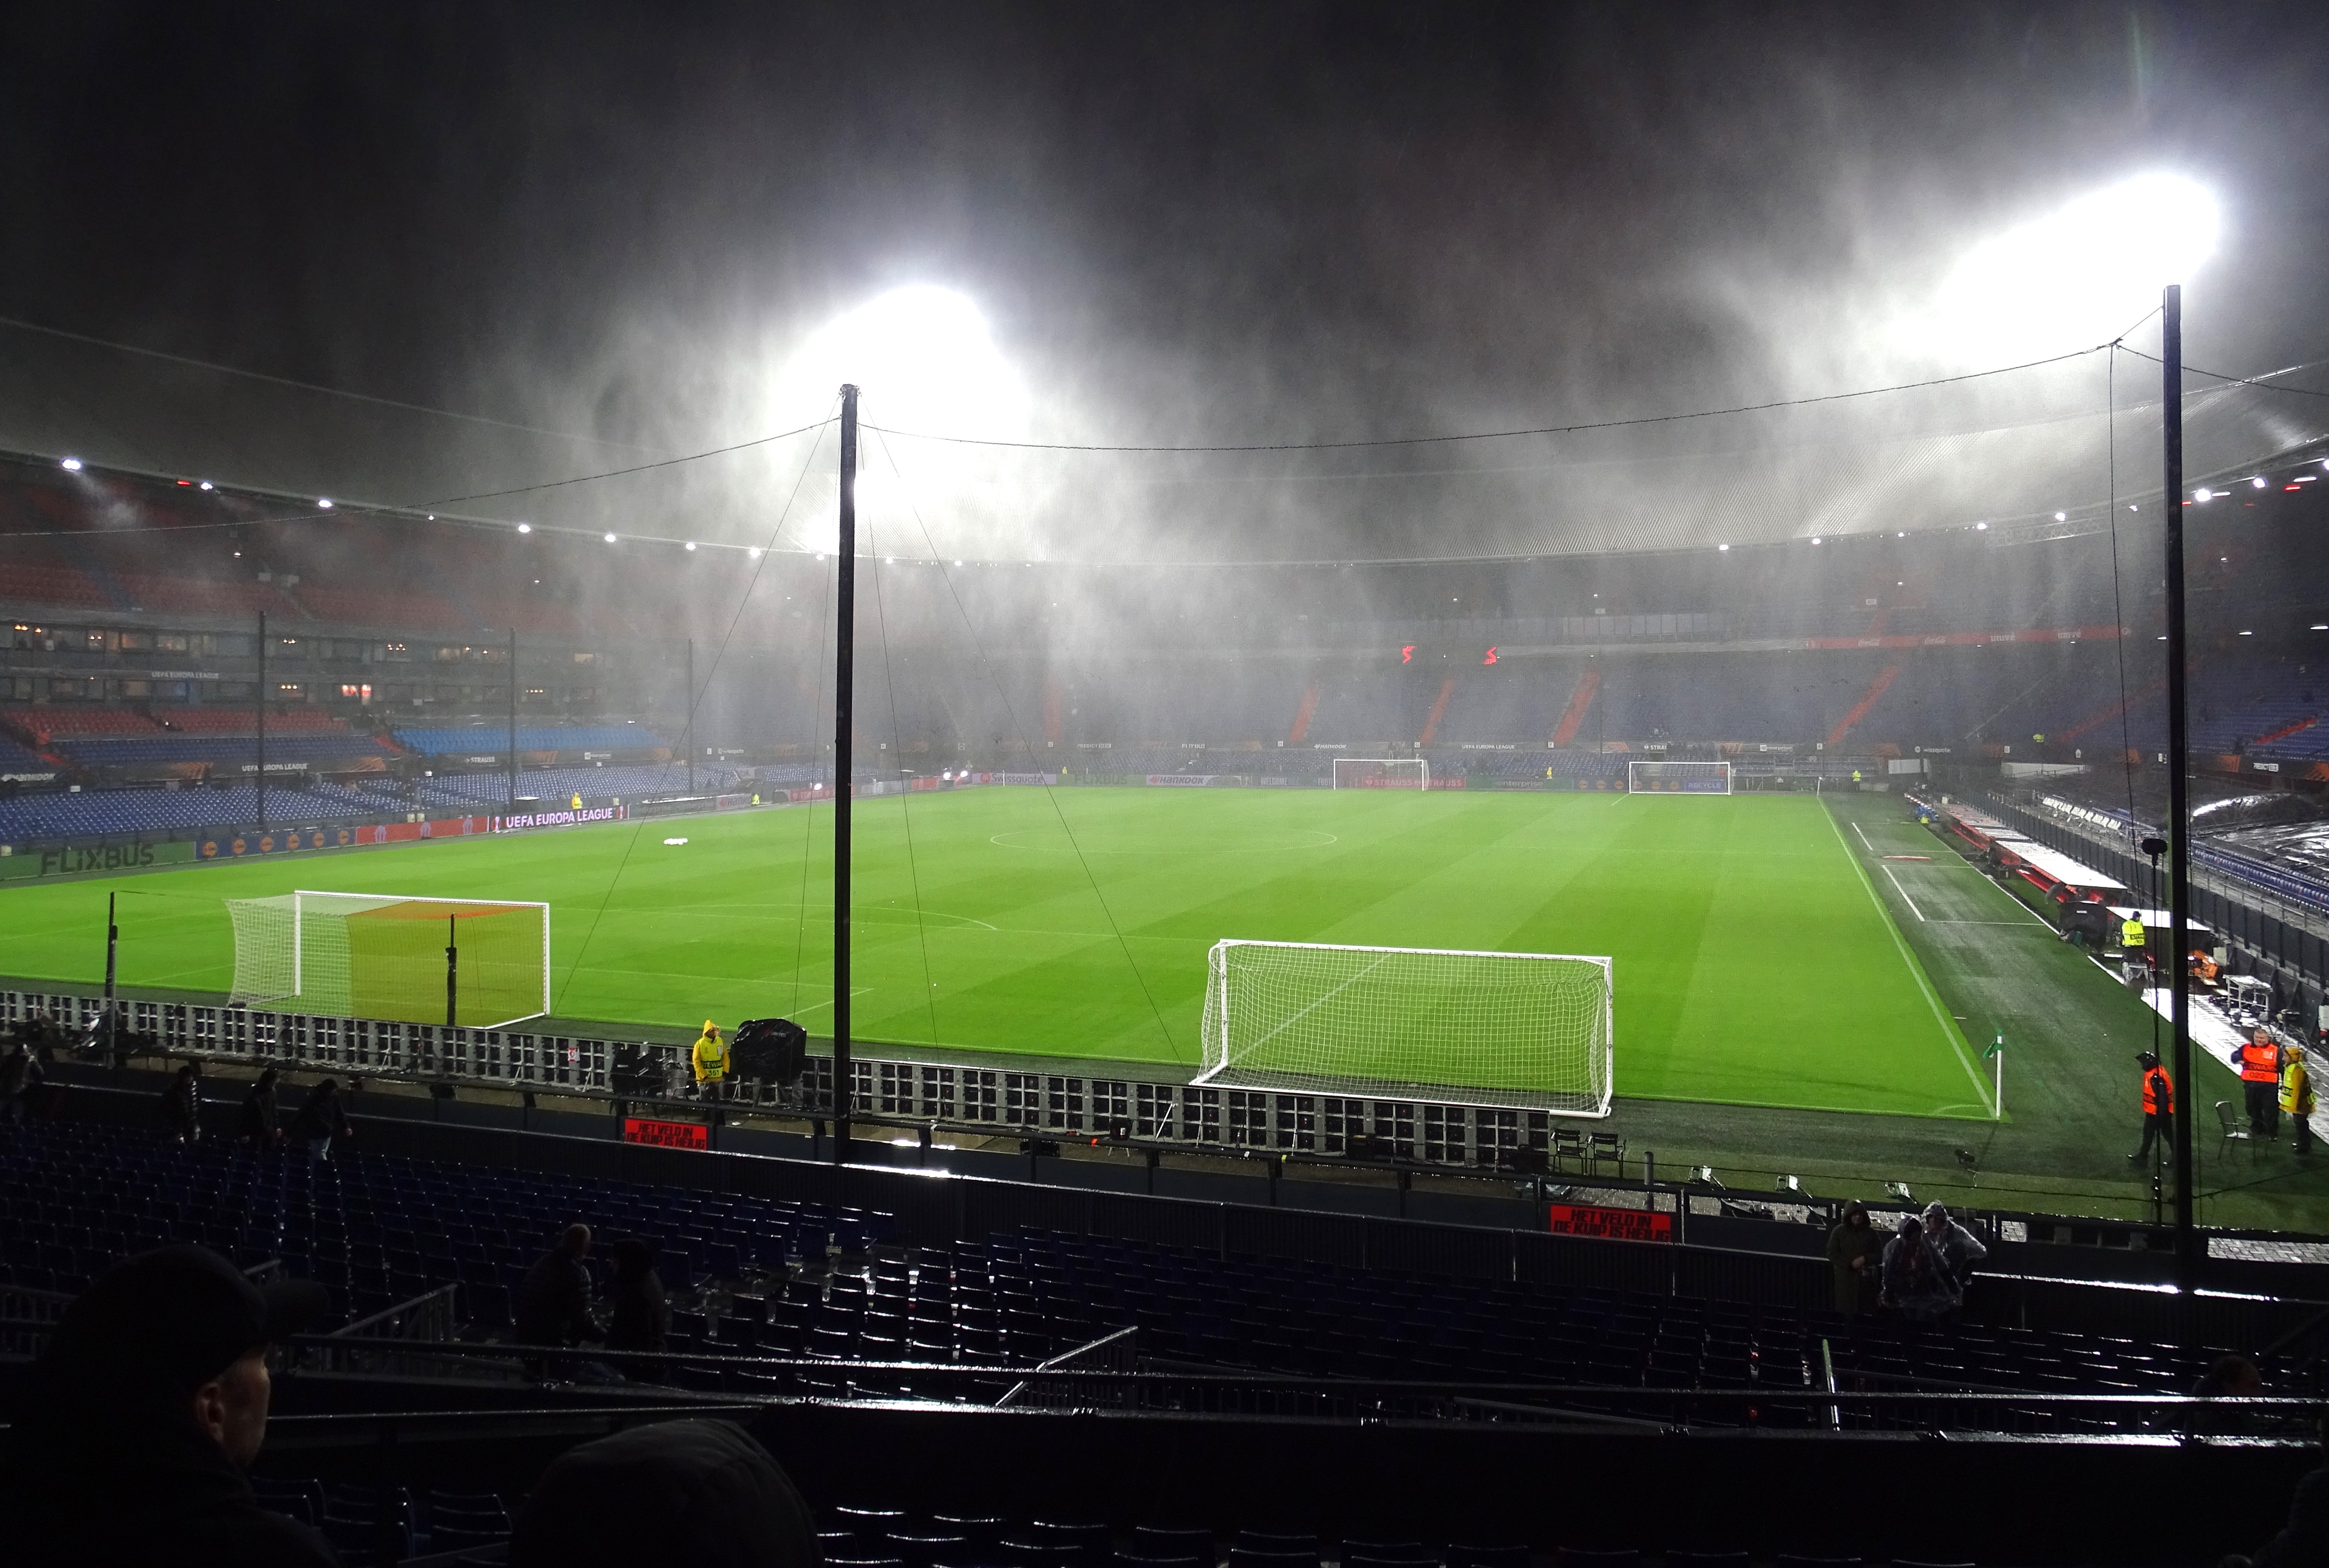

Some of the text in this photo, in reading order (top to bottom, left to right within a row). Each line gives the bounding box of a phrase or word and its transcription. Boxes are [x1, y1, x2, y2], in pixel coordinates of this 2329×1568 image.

[506, 807, 613, 828] UEFA EUROPA LEAGUE
[627, 1132, 639, 1142] DE
[640, 1134, 663, 1145] KUIP
[664, 1136, 674, 1147] IS
[639, 1123, 693, 1138] HET VELD IN
[1571, 1209, 1653, 1229] HET VELD IN
[1554, 1220, 1572, 1233] DE
[1573, 1222, 1608, 1237] KUIP
[1609, 1225, 1624, 1239] IS
